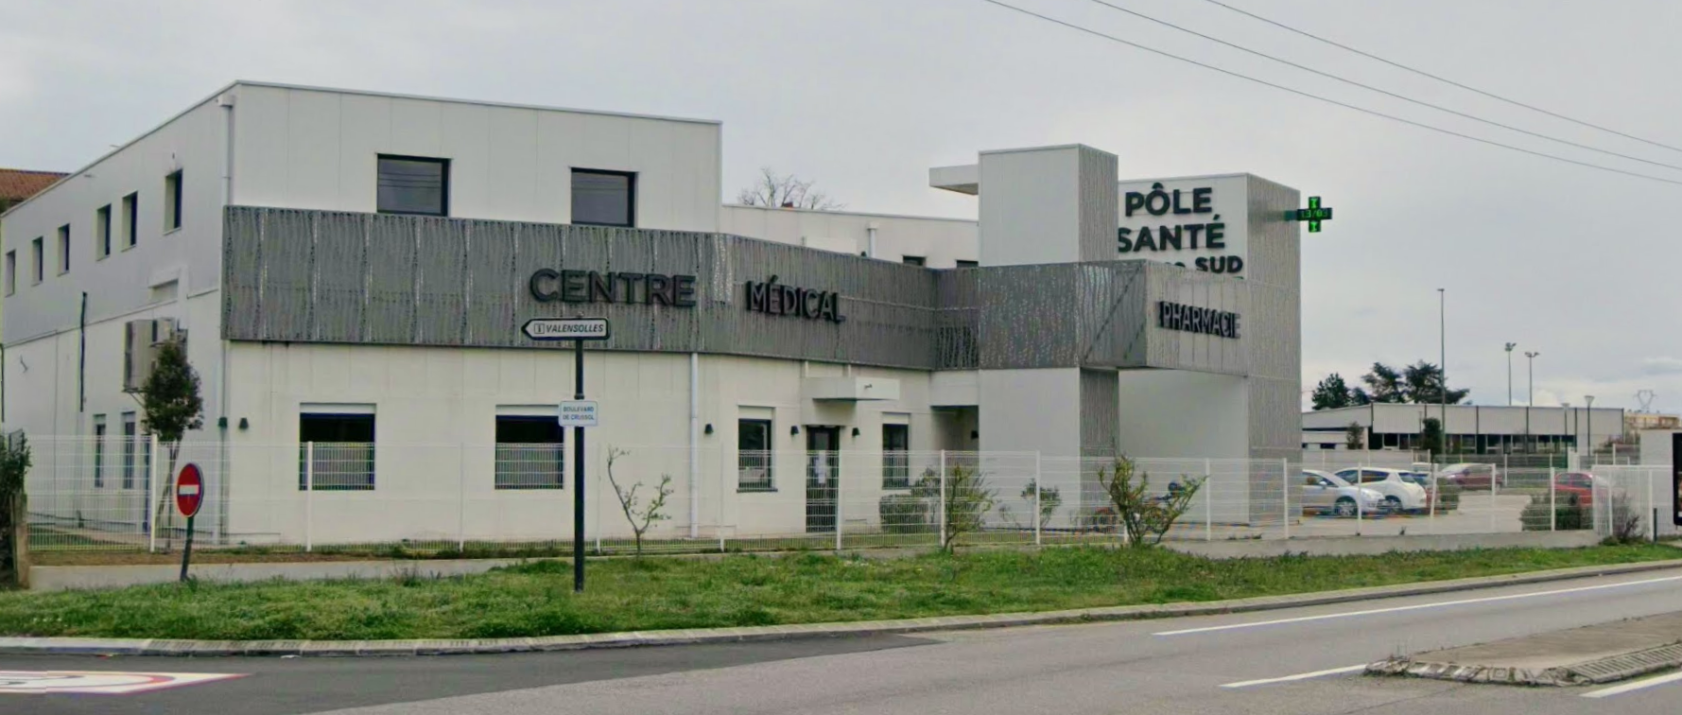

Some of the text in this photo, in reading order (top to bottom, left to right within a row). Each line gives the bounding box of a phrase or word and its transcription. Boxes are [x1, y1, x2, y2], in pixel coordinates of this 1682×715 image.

[1125, 182, 1213, 217] PÔLE
[1118, 214, 1226, 252] SANTÉ
[1195, 255, 1243, 274] SUD
[530, 268, 846, 324] CENTRE MÉDICAL
[546, 323, 604, 333] VALENSOLLES
[1158, 300, 1242, 339] PHARMACIE
